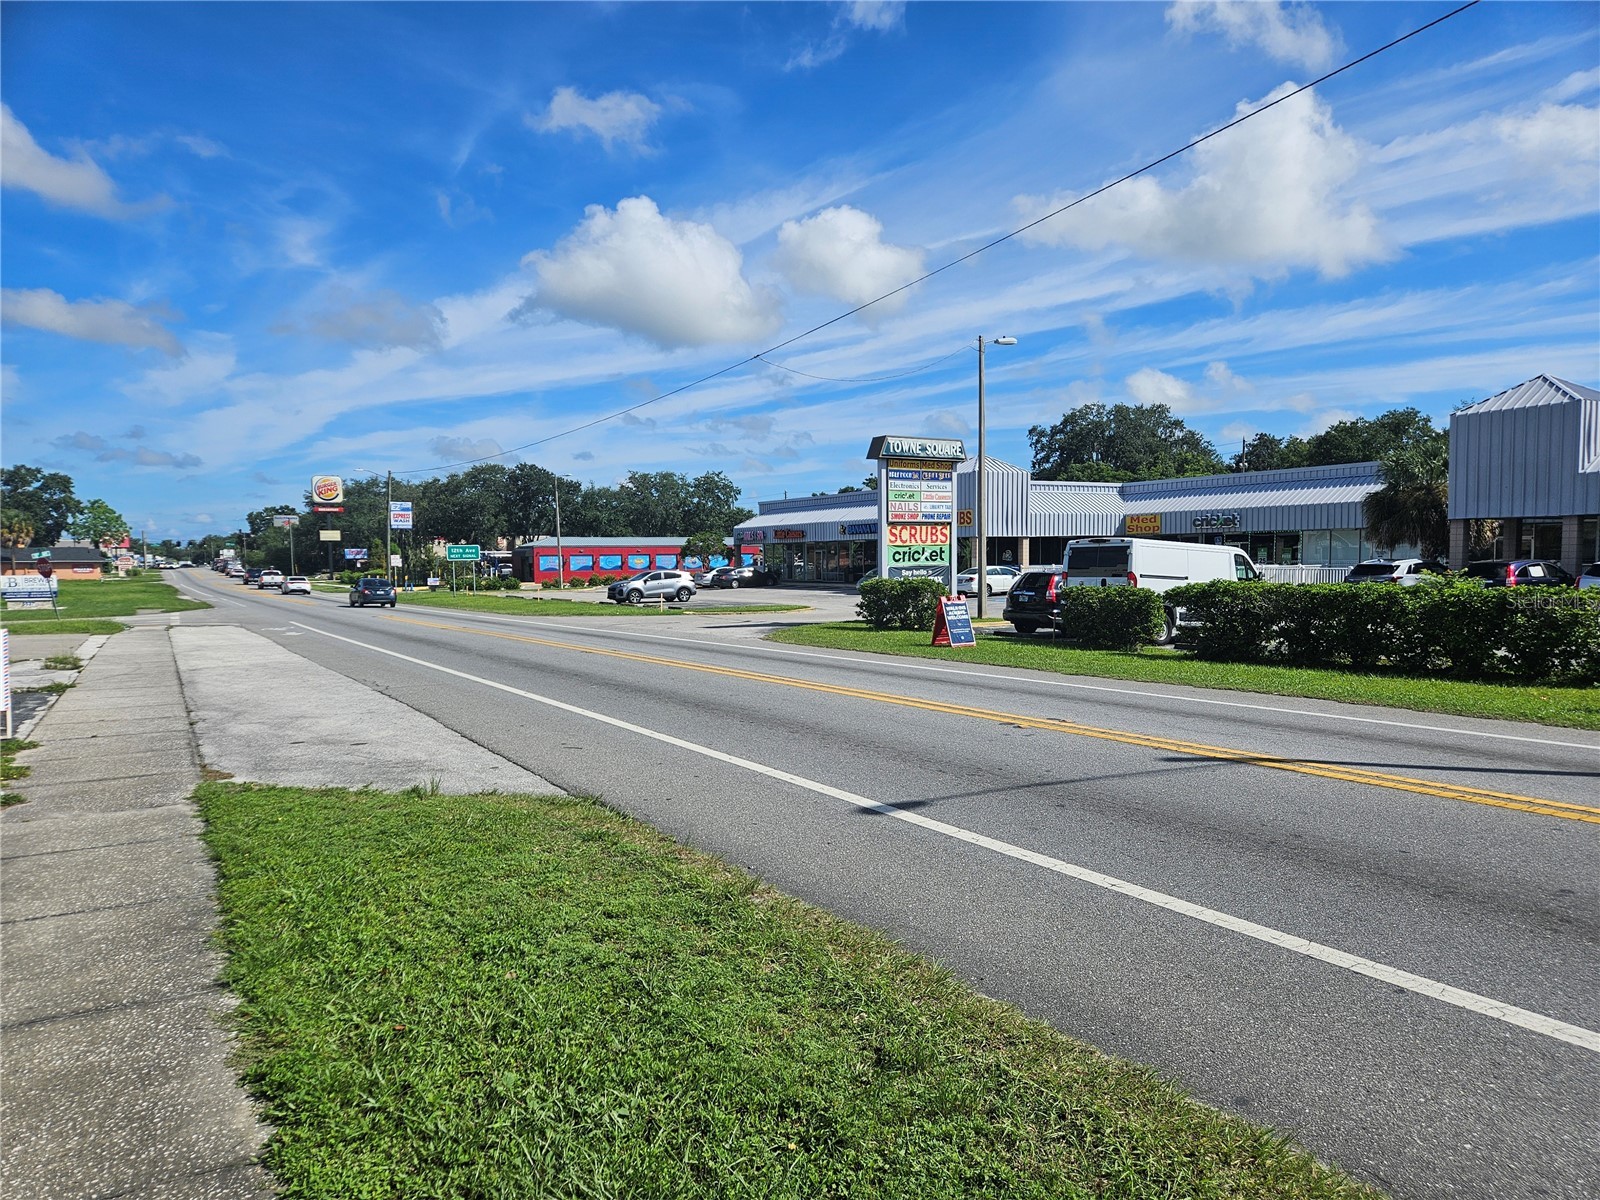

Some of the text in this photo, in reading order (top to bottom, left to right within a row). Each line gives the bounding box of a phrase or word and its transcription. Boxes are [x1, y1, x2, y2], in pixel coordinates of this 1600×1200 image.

[888, 440, 962, 456] TOWNE SQUARE
[889, 460, 920, 468] Uniforms
[922, 461, 952, 470] Med Shop
[317, 482, 337, 490] BURGER
[318, 486, 338, 496] KING
[890, 502, 919, 511] NAILS
[890, 512, 906, 520] SMOKE
[1129, 515, 1157, 524] Med
[1192, 512, 1240, 529] cricket
[1127, 524, 1160, 533] Shop
[889, 525, 948, 543] SCRUBS
[892, 546, 945, 562] cricket
[901, 569, 913, 577] Say
